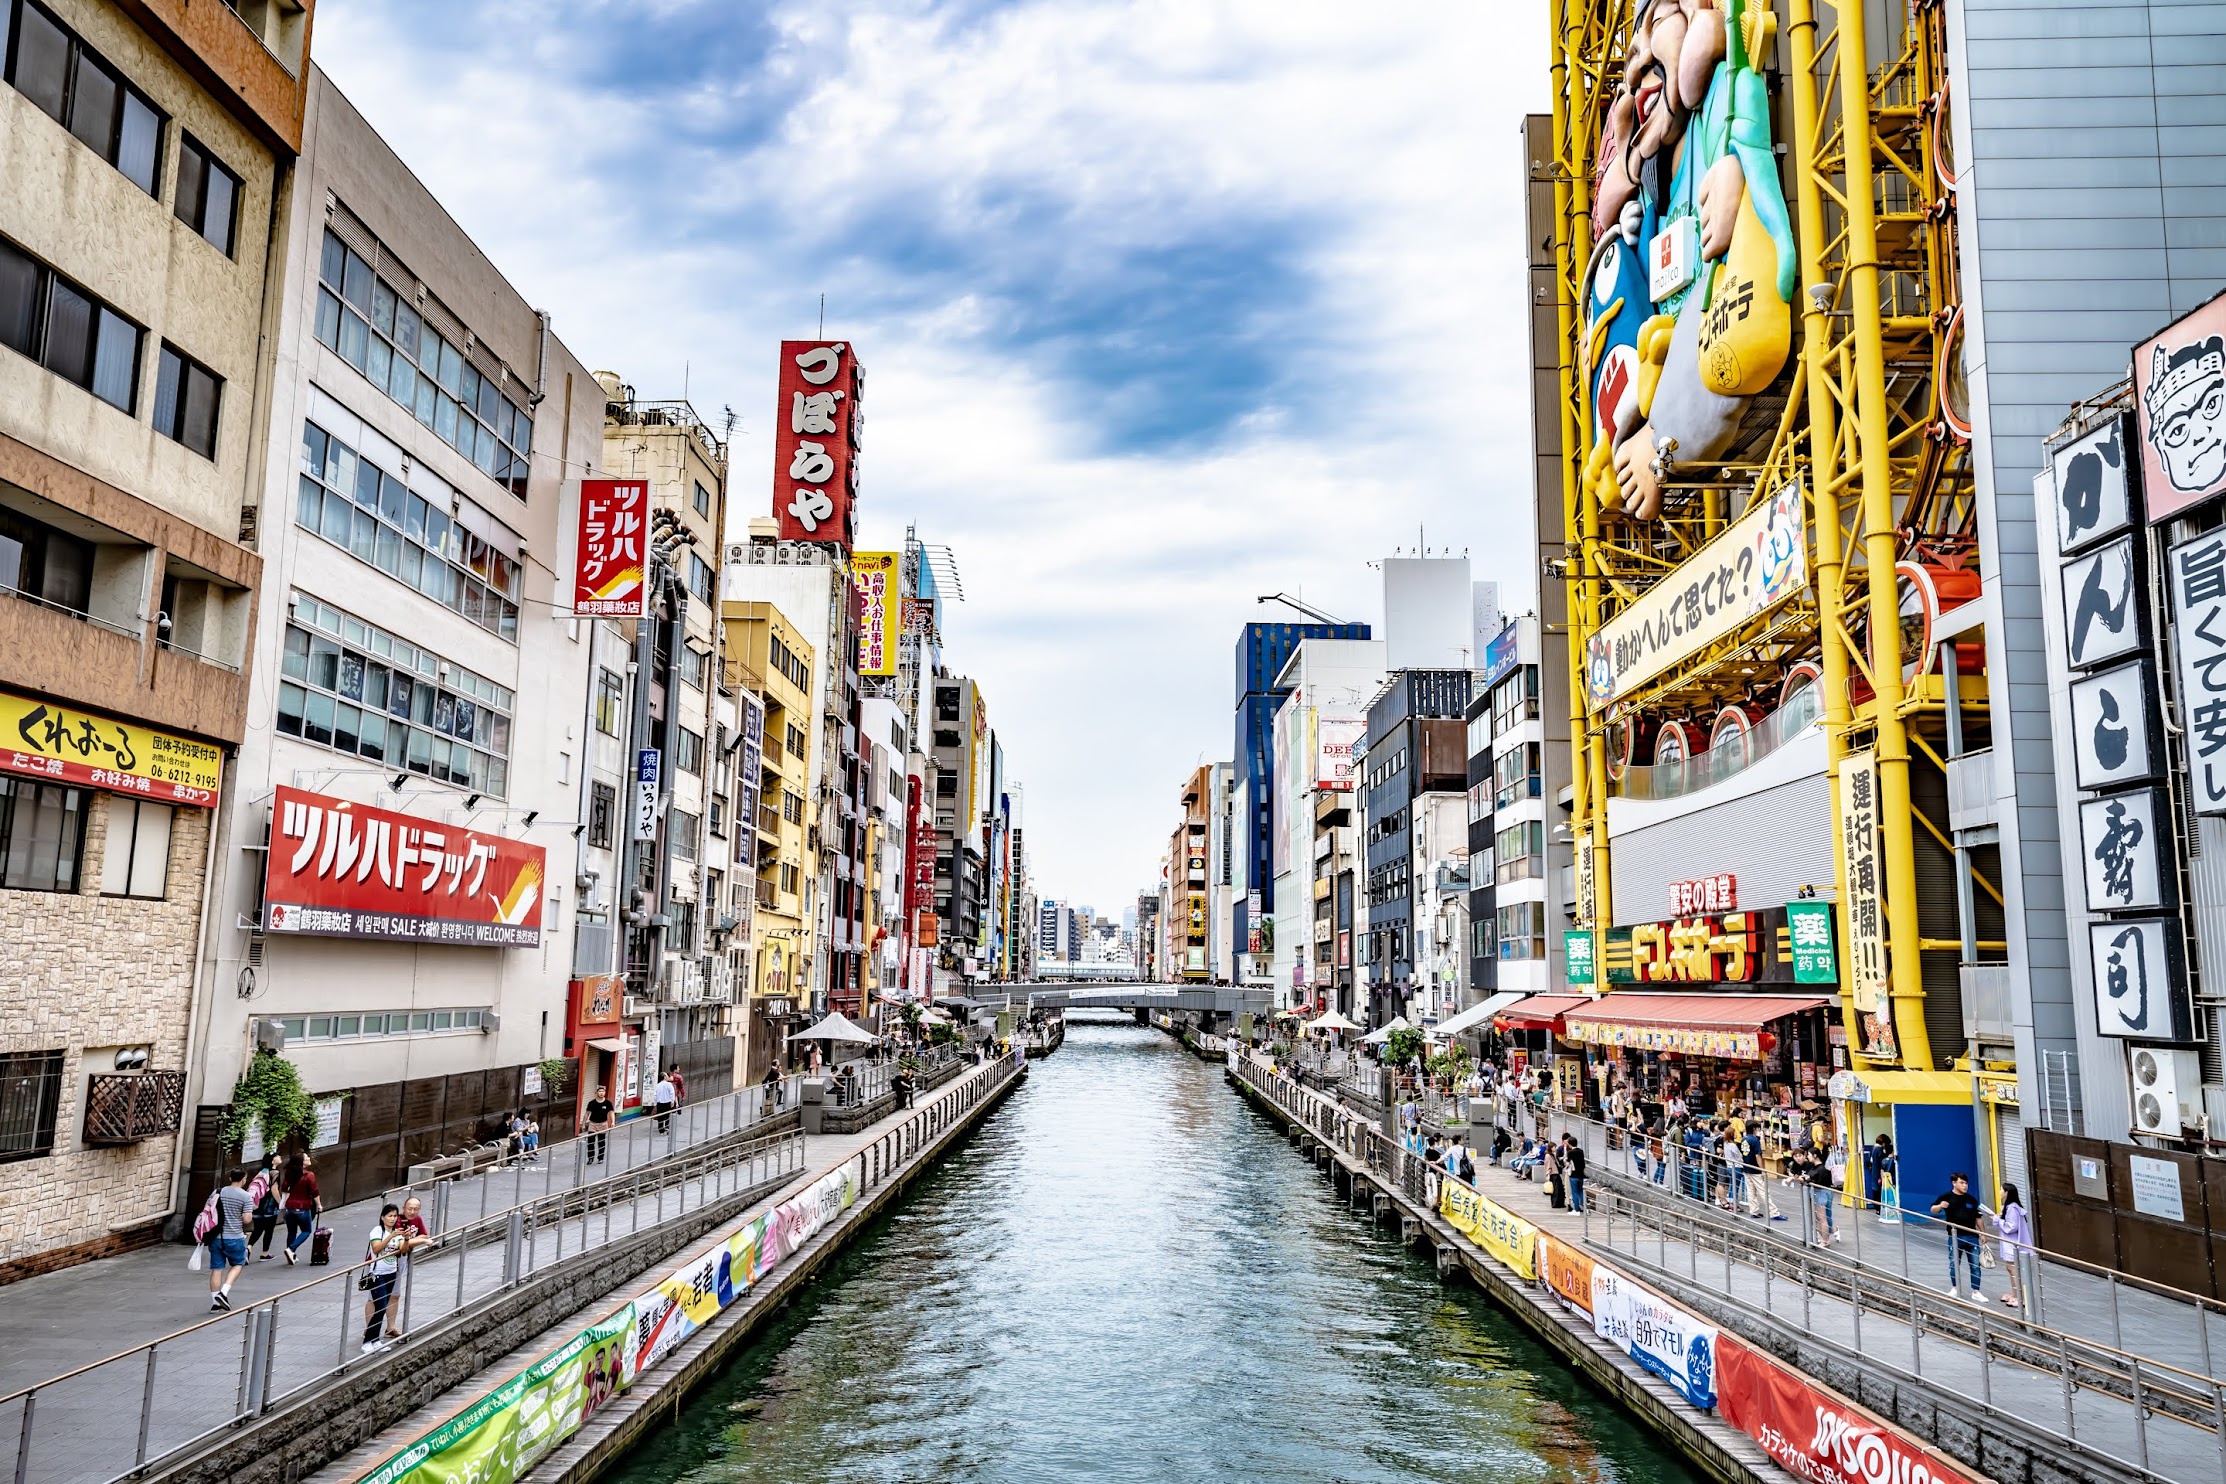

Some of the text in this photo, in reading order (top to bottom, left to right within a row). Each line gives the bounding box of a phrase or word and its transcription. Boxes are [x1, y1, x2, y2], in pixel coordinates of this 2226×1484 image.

[788, 342, 846, 532] づぼらや
[583, 500, 611, 581] ドラッグ
[609, 486, 641, 562] ツルハ
[869, 572, 885, 669] 高収入お仕事情報
[19, 704, 136, 770] くれおーる
[152, 735, 218, 762] 団体予約受付中
[12, 752, 210, 802] たこ焼 お好み焼 串かつ
[151, 753, 191, 768] お問い合わせは
[151, 764, 217, 789] 06-6212-9195
[643, 753, 657, 780] 焼肉
[640, 783, 654, 838] いろりや
[282, 800, 497, 898] ツルハドラッグ
[1669, 874, 1733, 916] 驚安の殿堂
[355, 914, 390, 934] 세일판매
[390, 917, 417, 937] SALE
[440, 923, 475, 941] 환영합니다
[476, 924, 516, 943] WELCOME
[1792, 912, 1829, 946] 薬
[1567, 938, 1591, 960] 薬
[1798, 956, 1813, 971] 药
[1816, 955, 1832, 972] 약
[1635, 1319, 1685, 1357] 自分でマモル
[1758, 1422, 1853, 1484] カラオケのご用
[1810, 1405, 1946, 1484] JOYSOU
